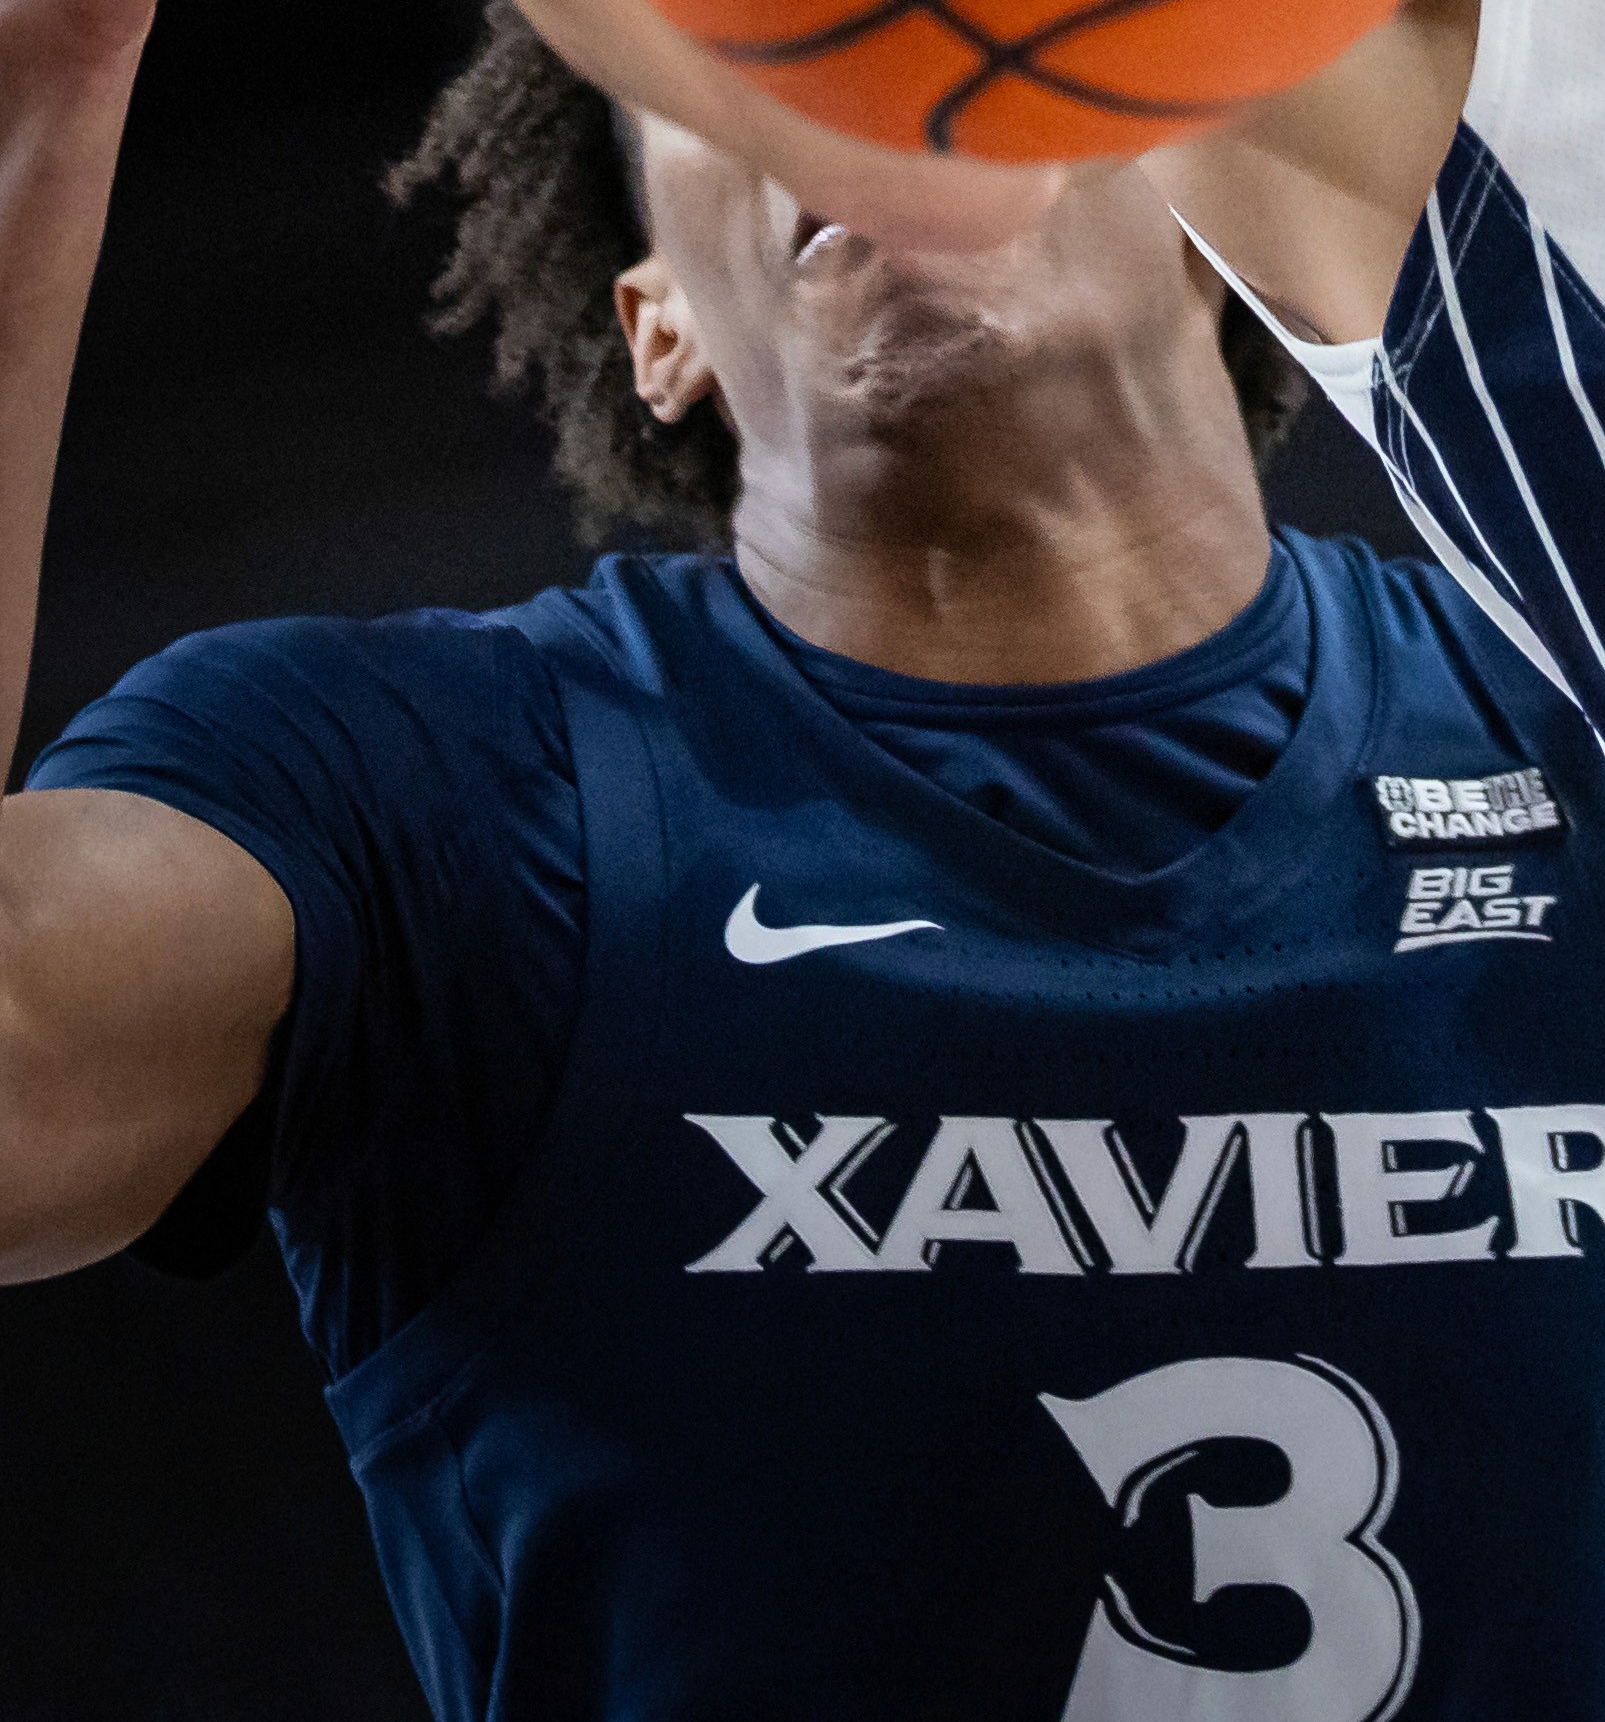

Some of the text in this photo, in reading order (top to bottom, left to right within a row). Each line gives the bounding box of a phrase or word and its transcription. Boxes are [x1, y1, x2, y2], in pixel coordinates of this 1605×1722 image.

[1390, 801, 1560, 839] CHANGE
[1406, 864, 1515, 900] BIG
[1400, 895, 1558, 934] EAST
[1037, 1351, 1421, 1722] 3
